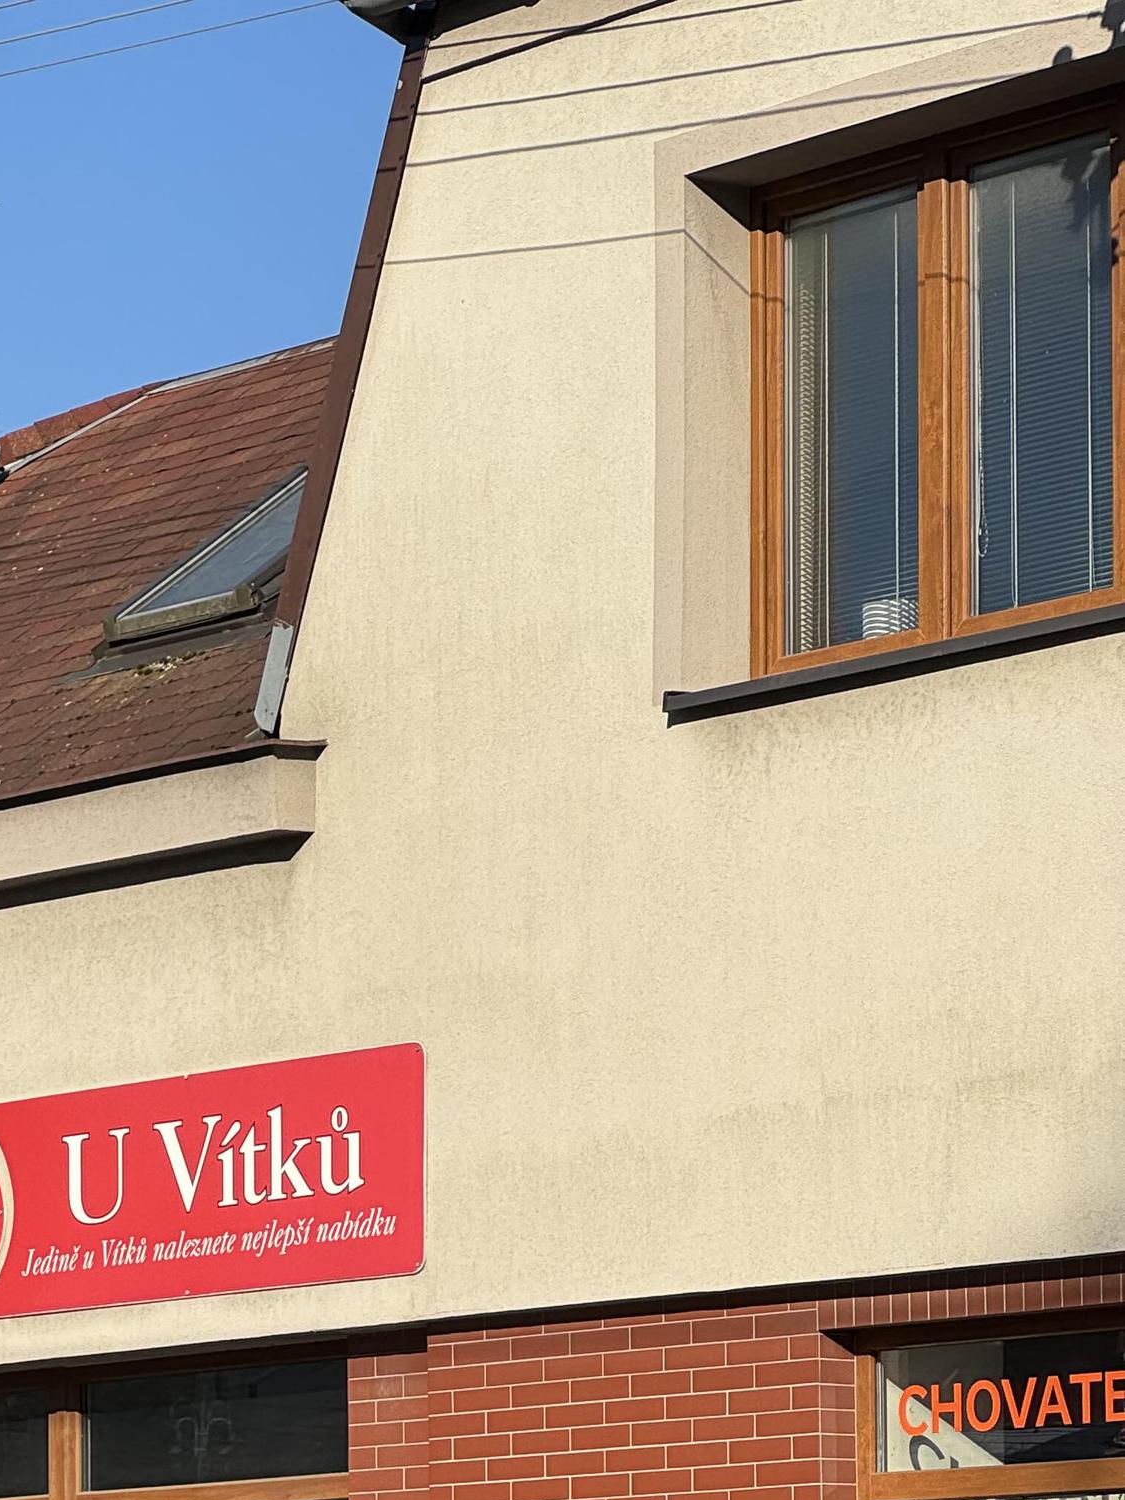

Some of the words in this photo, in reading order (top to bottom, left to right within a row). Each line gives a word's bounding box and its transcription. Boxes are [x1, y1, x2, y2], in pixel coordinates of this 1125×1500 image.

[61, 1127, 130, 1226] U
[152, 1104, 365, 1214] Vítků
[21, 1244, 82, 1277] Jedině
[82, 1250, 95, 1270] u
[101, 1236, 148, 1268] Vítků
[152, 1229, 237, 1263] naleznete
[240, 1216, 315, 1258] nejlepší
[316, 1206, 397, 1244] nabídku
[898, 1370, 1125, 1437] CHOVATE
